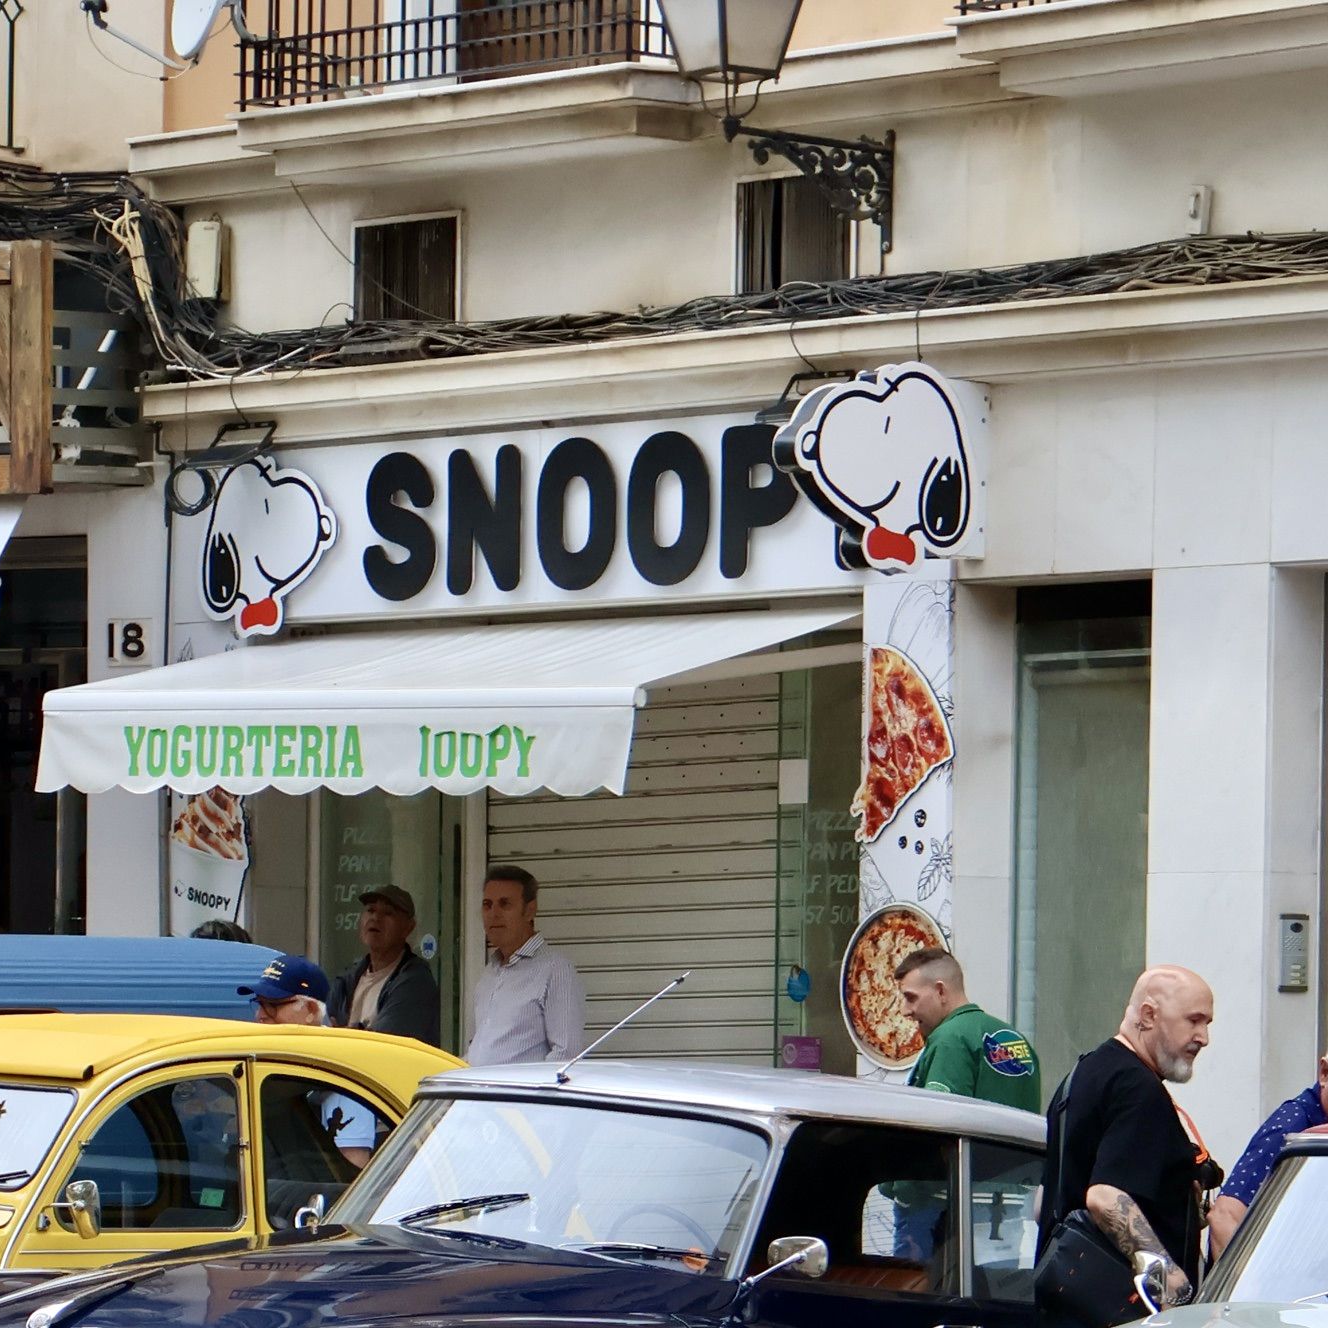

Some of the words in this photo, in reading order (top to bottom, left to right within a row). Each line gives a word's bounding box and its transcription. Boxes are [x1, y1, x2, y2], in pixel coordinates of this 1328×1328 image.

[362, 423, 868, 601] SNOOP
[108, 622, 145, 658] 18
[123, 725, 364, 778] YOGURTERIA
[188, 886, 231, 911] SNOOPY
